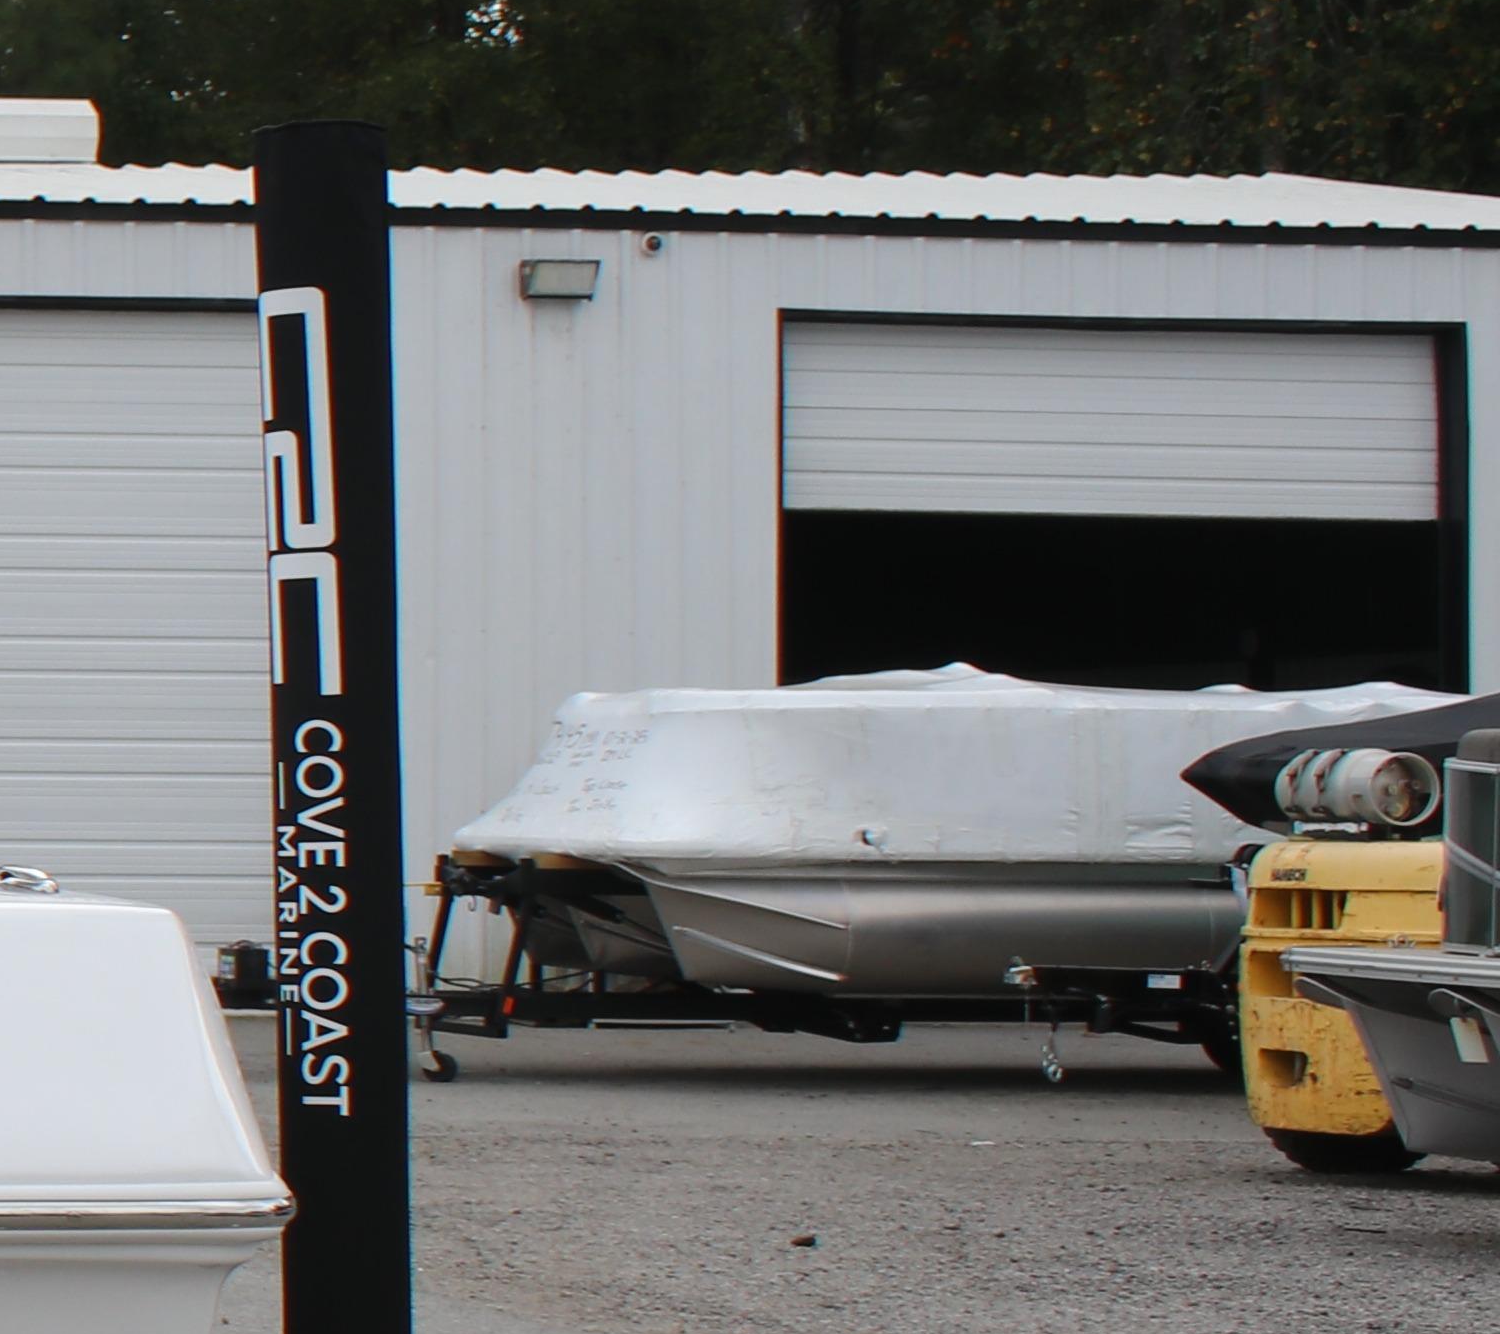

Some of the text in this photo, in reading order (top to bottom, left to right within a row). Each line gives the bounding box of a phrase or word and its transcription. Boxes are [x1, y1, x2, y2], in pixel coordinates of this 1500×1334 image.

[259, 286, 343, 696] C2C
[277, 825, 300, 1003] MARINE
[295, 719, 350, 1116] COVE 2 COAST
